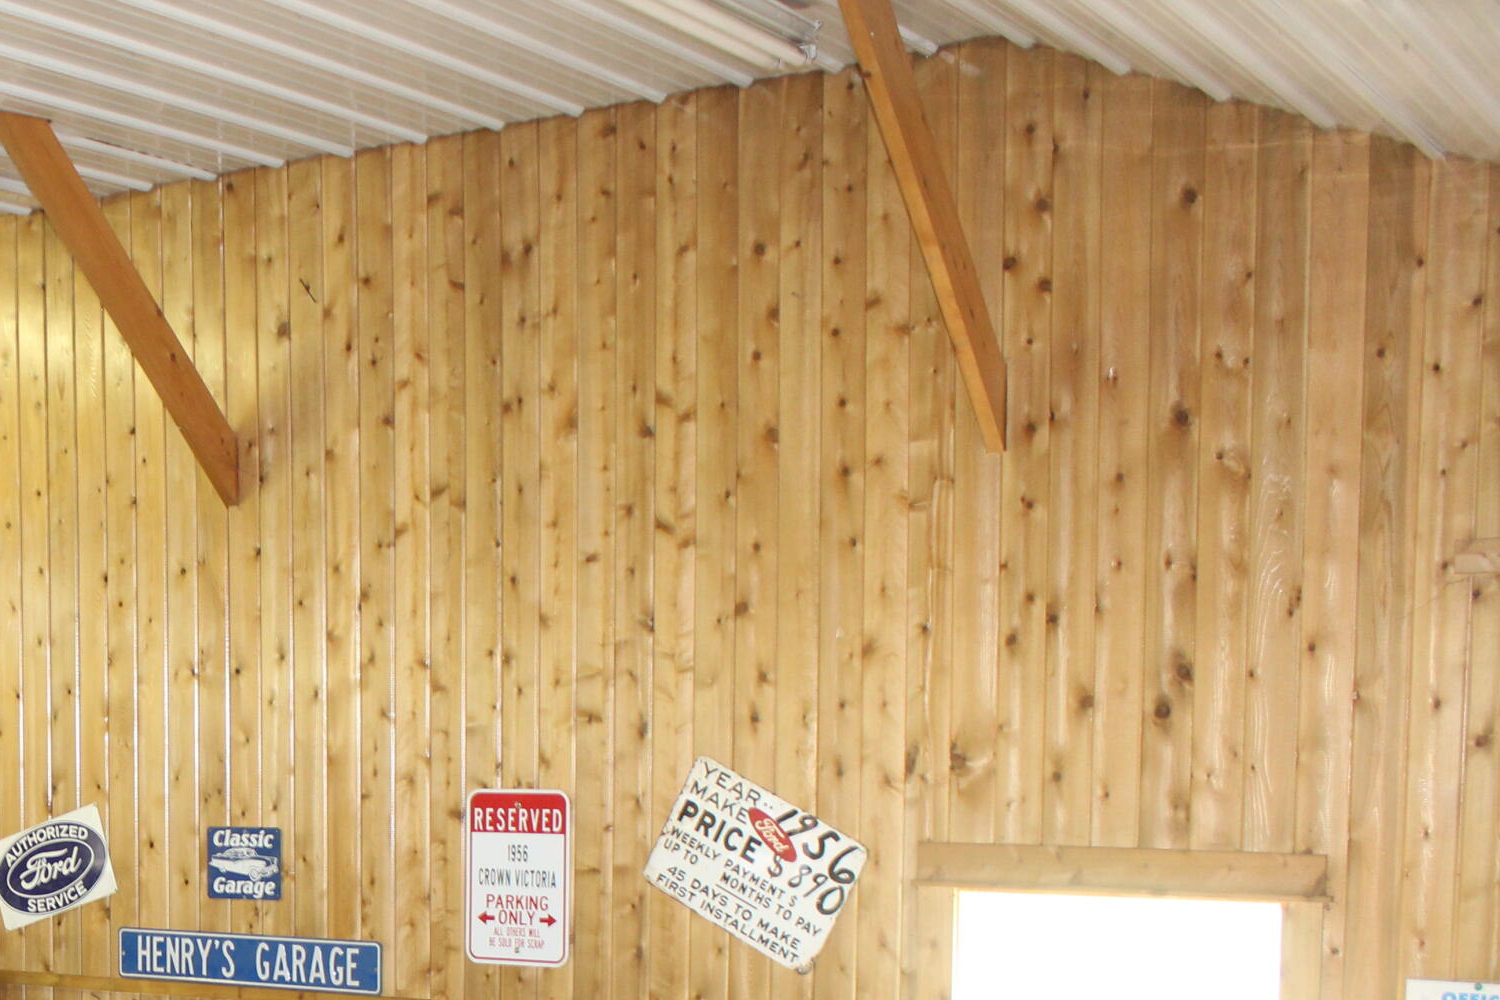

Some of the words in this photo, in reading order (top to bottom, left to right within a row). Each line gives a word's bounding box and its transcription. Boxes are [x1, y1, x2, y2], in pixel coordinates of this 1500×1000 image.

[474, 808, 563, 832] RESERVED
[690, 781, 749, 824] MAKE
[4, 824, 89, 868] AUTHORIZED
[213, 829, 274, 849] Classic
[678, 800, 762, 863] PRICE
[754, 818, 789, 853] Ford
[19, 846, 82, 891] Ford
[507, 844, 529, 862] 1956
[671, 825, 721, 860] WEEKLY
[724, 860, 785, 900] PAYMENT
[27, 880, 88, 913] SERVICE
[213, 876, 276, 899] Garage
[479, 868, 512, 887] CROWN
[515, 870, 557, 888] VICTORIA
[663, 838, 679, 853] UP
[682, 849, 699, 864] TO
[720, 872, 772, 909] MONTHS
[777, 904, 793, 921] TO
[795, 917, 822, 937] PAY
[486, 894, 549, 911] PARKING
[498, 909, 536, 926] ONLY
[656, 874, 700, 904] FIRST
[700, 901, 800, 963] INSTALLMENT
[667, 866, 685, 881] 45
[691, 878, 728, 906] DAYS
[735, 902, 753, 921] TO
[757, 917, 800, 950] MAKE
[137, 934, 236, 979] HENRY'S
[255, 942, 361, 987] GARAGE
